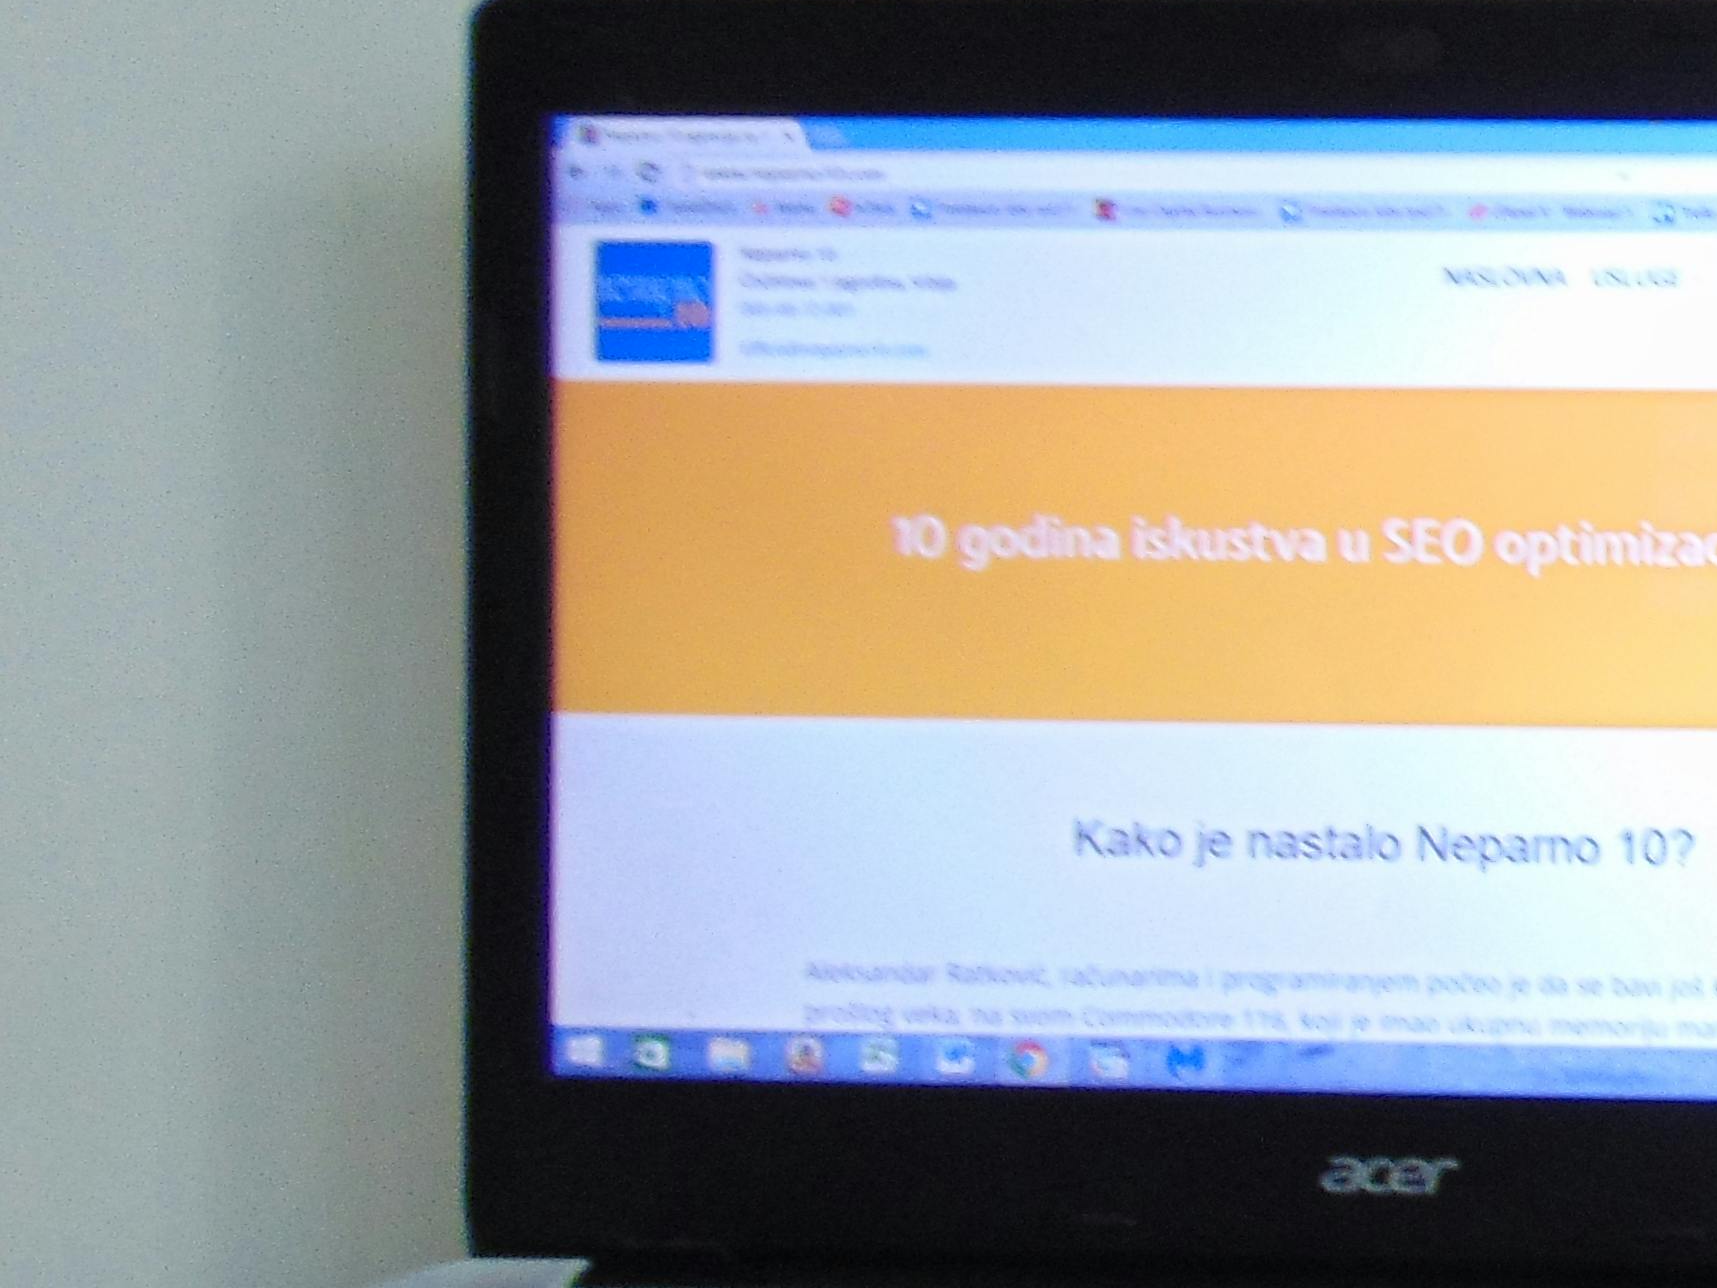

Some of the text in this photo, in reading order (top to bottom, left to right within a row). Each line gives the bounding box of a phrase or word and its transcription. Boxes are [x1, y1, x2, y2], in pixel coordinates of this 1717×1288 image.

[890, 516, 948, 558] 10
[957, 518, 1120, 570] godina
[1130, 516, 1330, 562] iskustva
[1338, 528, 1371, 564] u
[1381, 520, 1482, 567] SEO
[1074, 818, 1183, 858] Kako
[1191, 822, 1233, 867] je
[1247, 824, 1401, 860] nastalo
[1620, 828, 1697, 865] 10?
[1319, 1152, 1461, 1195] acer
